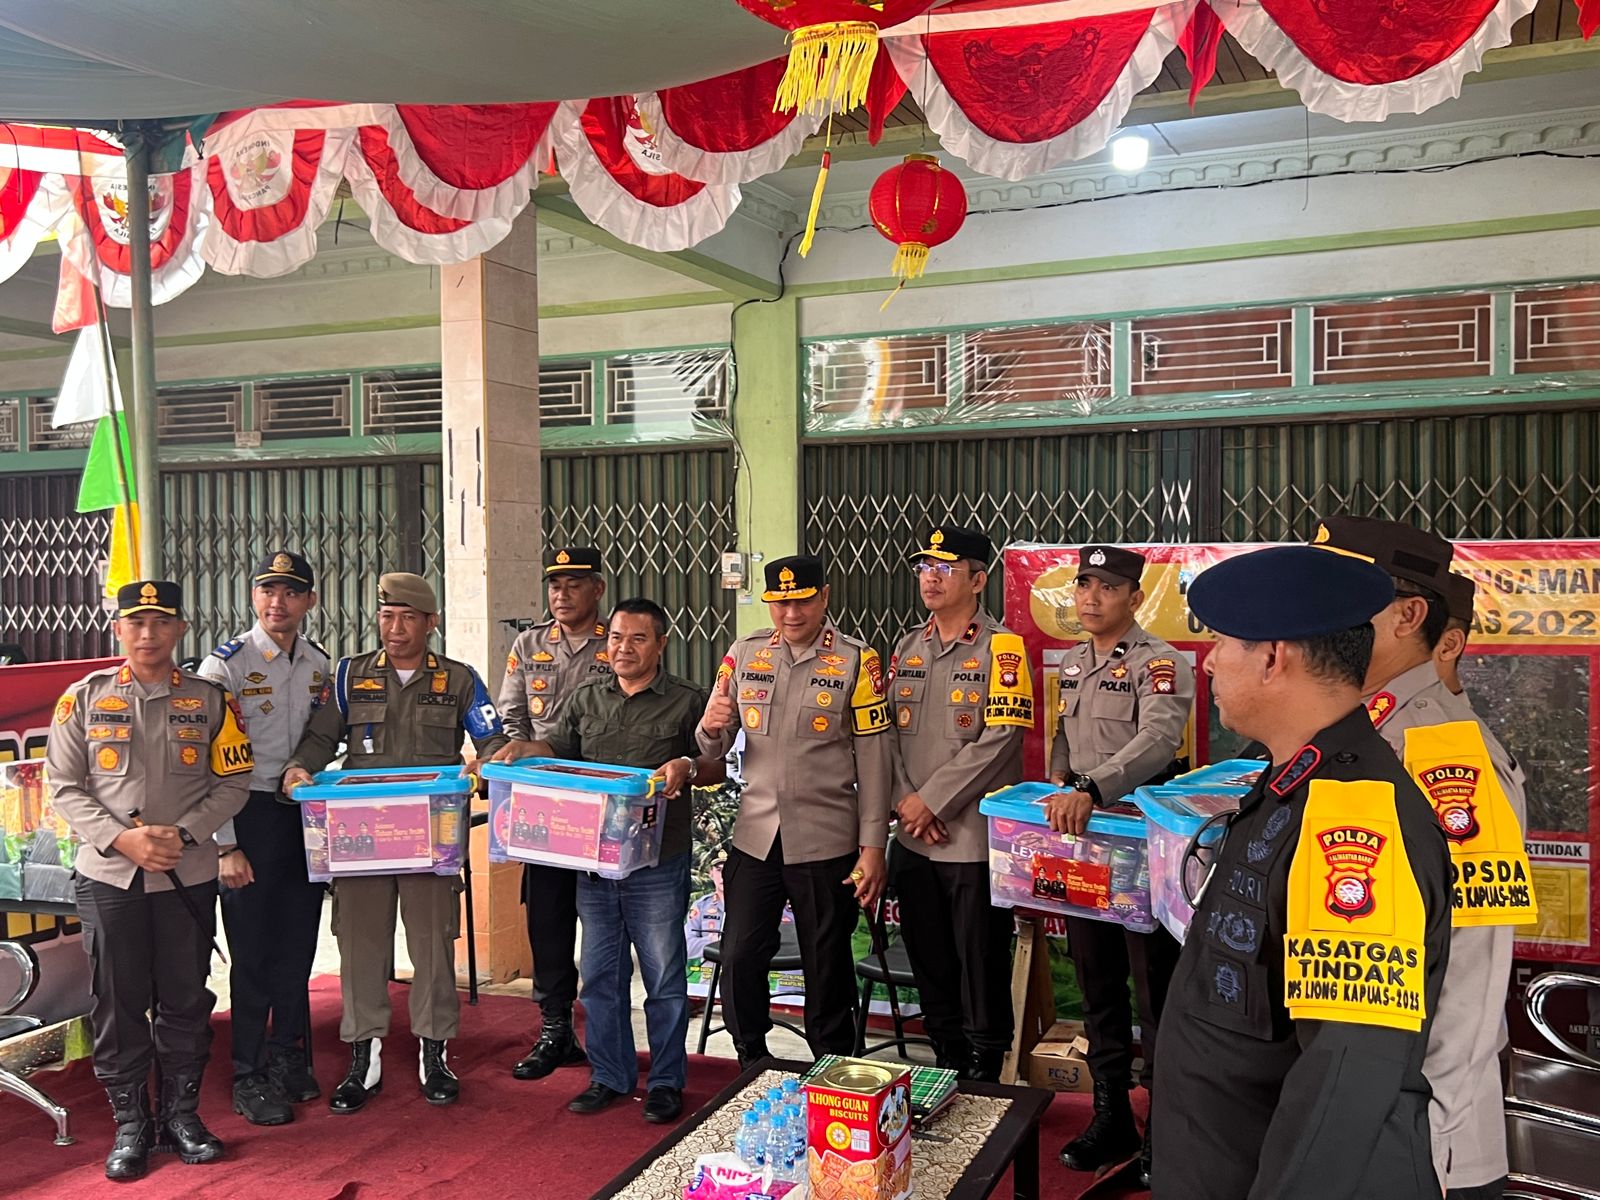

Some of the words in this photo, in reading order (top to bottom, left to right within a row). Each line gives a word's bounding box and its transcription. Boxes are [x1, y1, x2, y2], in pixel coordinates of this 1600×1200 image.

[588, 664, 612, 675] POL
[953, 671, 986, 682] POLRI
[811, 678, 844, 690] POLRI
[1099, 680, 1131, 692] POLRI
[169, 715, 208, 724] POLRI
[1426, 768, 1475, 784] POLDA
[1322, 829, 1379, 850] POLDA
[1011, 843, 1055, 859] LEX
[1524, 843, 1583, 857] RTINDAK
[1288, 938, 1418, 968] KASATGAS
[1299, 959, 1405, 987] TINDAK
[1305, 980, 1338, 1000] LIONG
[809, 1091, 841, 1108] KHONG
[842, 1098, 869, 1113] GUAN
[829, 1108, 868, 1122] BISCUITS
